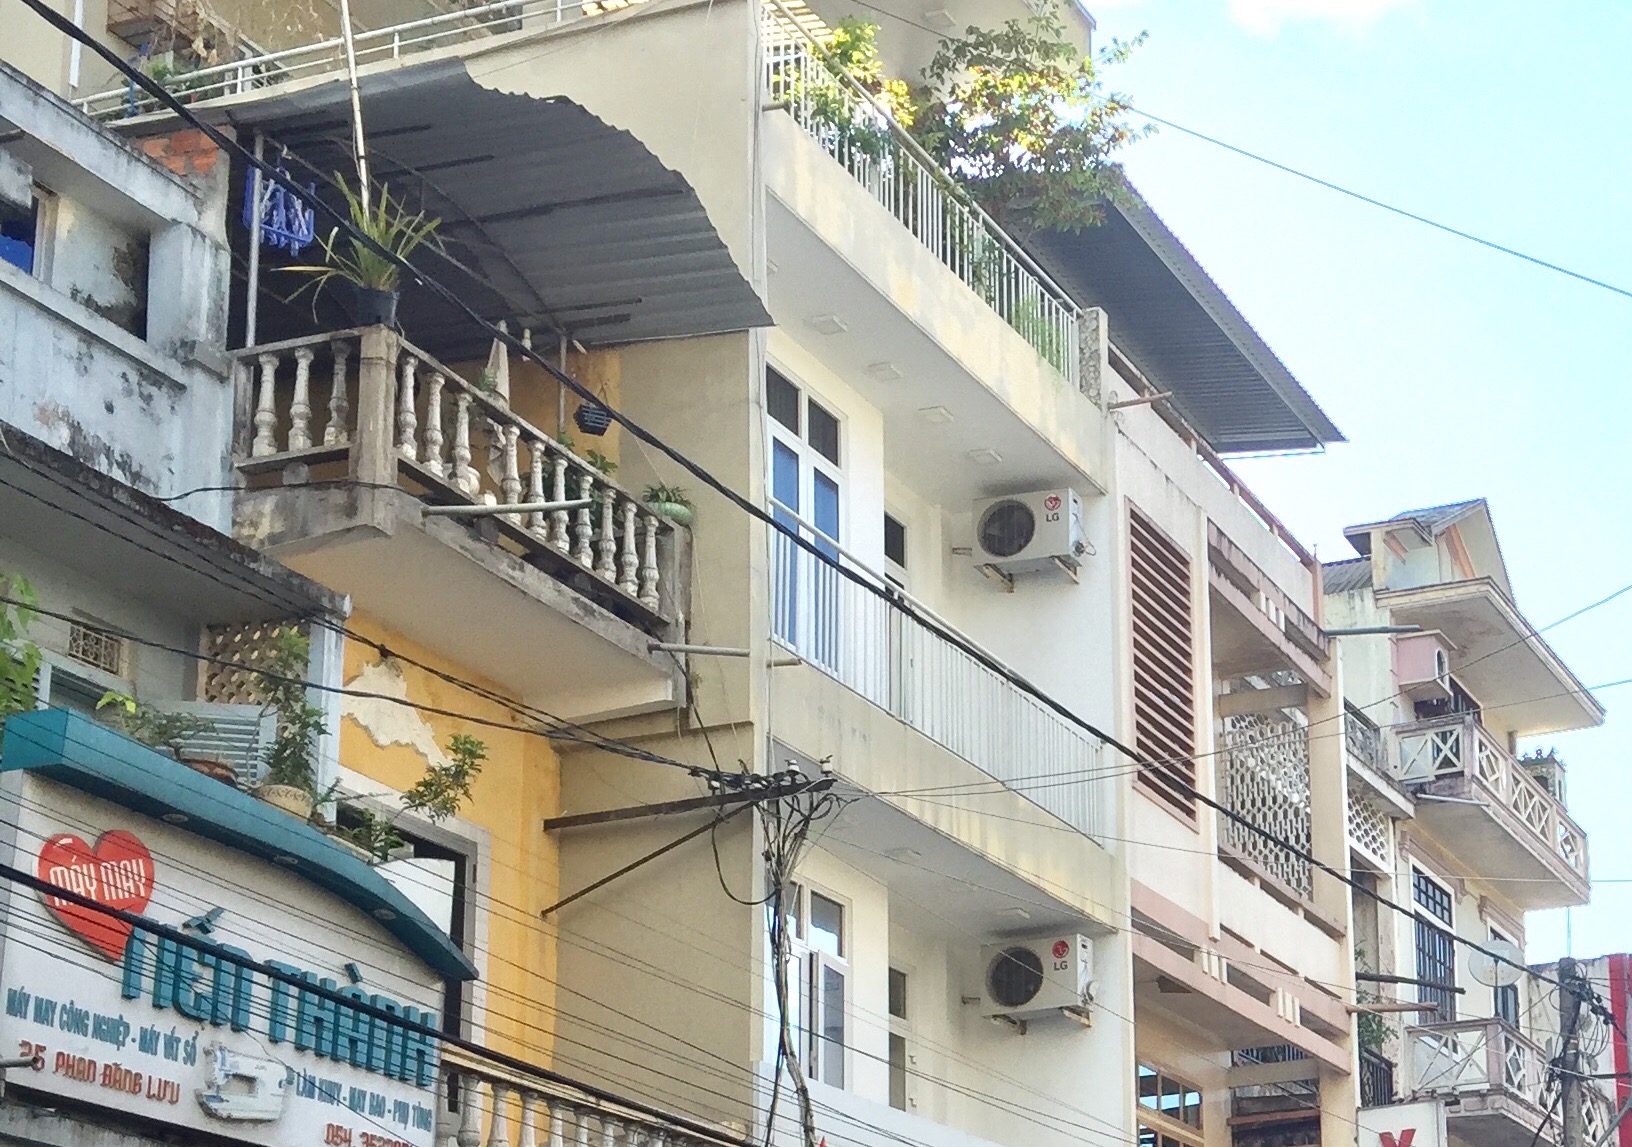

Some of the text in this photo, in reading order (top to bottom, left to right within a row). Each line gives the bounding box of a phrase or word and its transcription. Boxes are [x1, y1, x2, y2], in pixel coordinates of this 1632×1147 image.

[1045, 512, 1060, 523] LG
[102, 858, 145, 900] MAY
[1053, 961, 1068, 971] LG
[59, 1000, 90, 1037] CÔNG
[92, 1014, 130, 1050] NGHIỆP
[54, 1051, 180, 1105] PHAN ĐĂNG LƯU
